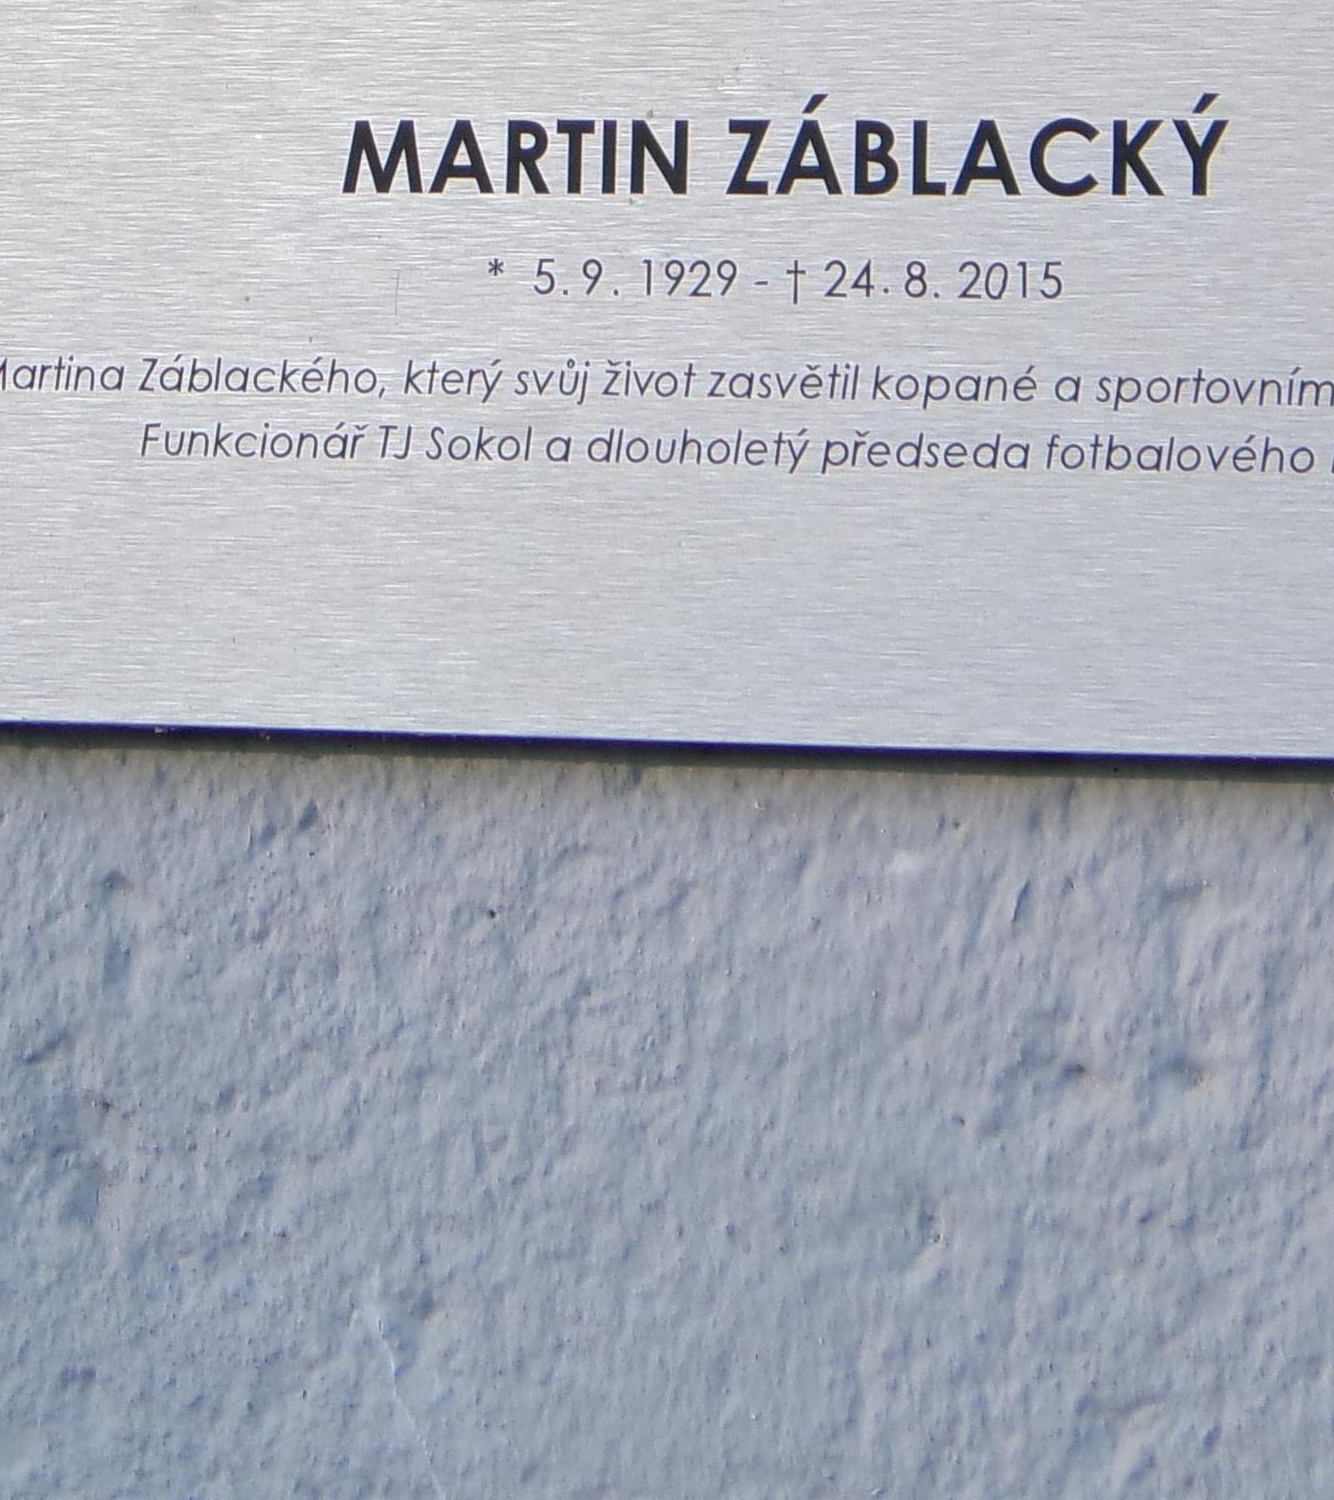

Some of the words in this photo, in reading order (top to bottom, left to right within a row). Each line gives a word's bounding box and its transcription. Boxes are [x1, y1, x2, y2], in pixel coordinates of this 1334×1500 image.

[342, 118, 689, 196] MARTIN
[725, 92, 1229, 198] ZÁBLACKÝ
[642, 259, 737, 298] 1929
[957, 260, 1063, 301] 2015
[138, 353, 386, 399] Záblackého,
[404, 358, 503, 404] který
[514, 358, 591, 406] svůj
[601, 359, 697, 398] život
[707, 363, 860, 401] zasvětil
[872, 364, 1037, 410] kopané
[1054, 376, 1082, 403] a
[140, 421, 368, 460] Funkcionář
[378, 424, 413, 460] TJ
[425, 425, 533, 462] Sokol
[545, 436, 572, 463] a
[587, 428, 810, 474] dlouholetý
[821, 430, 1030, 475] předseda
[1046, 433, 1315, 474] fotbalového
